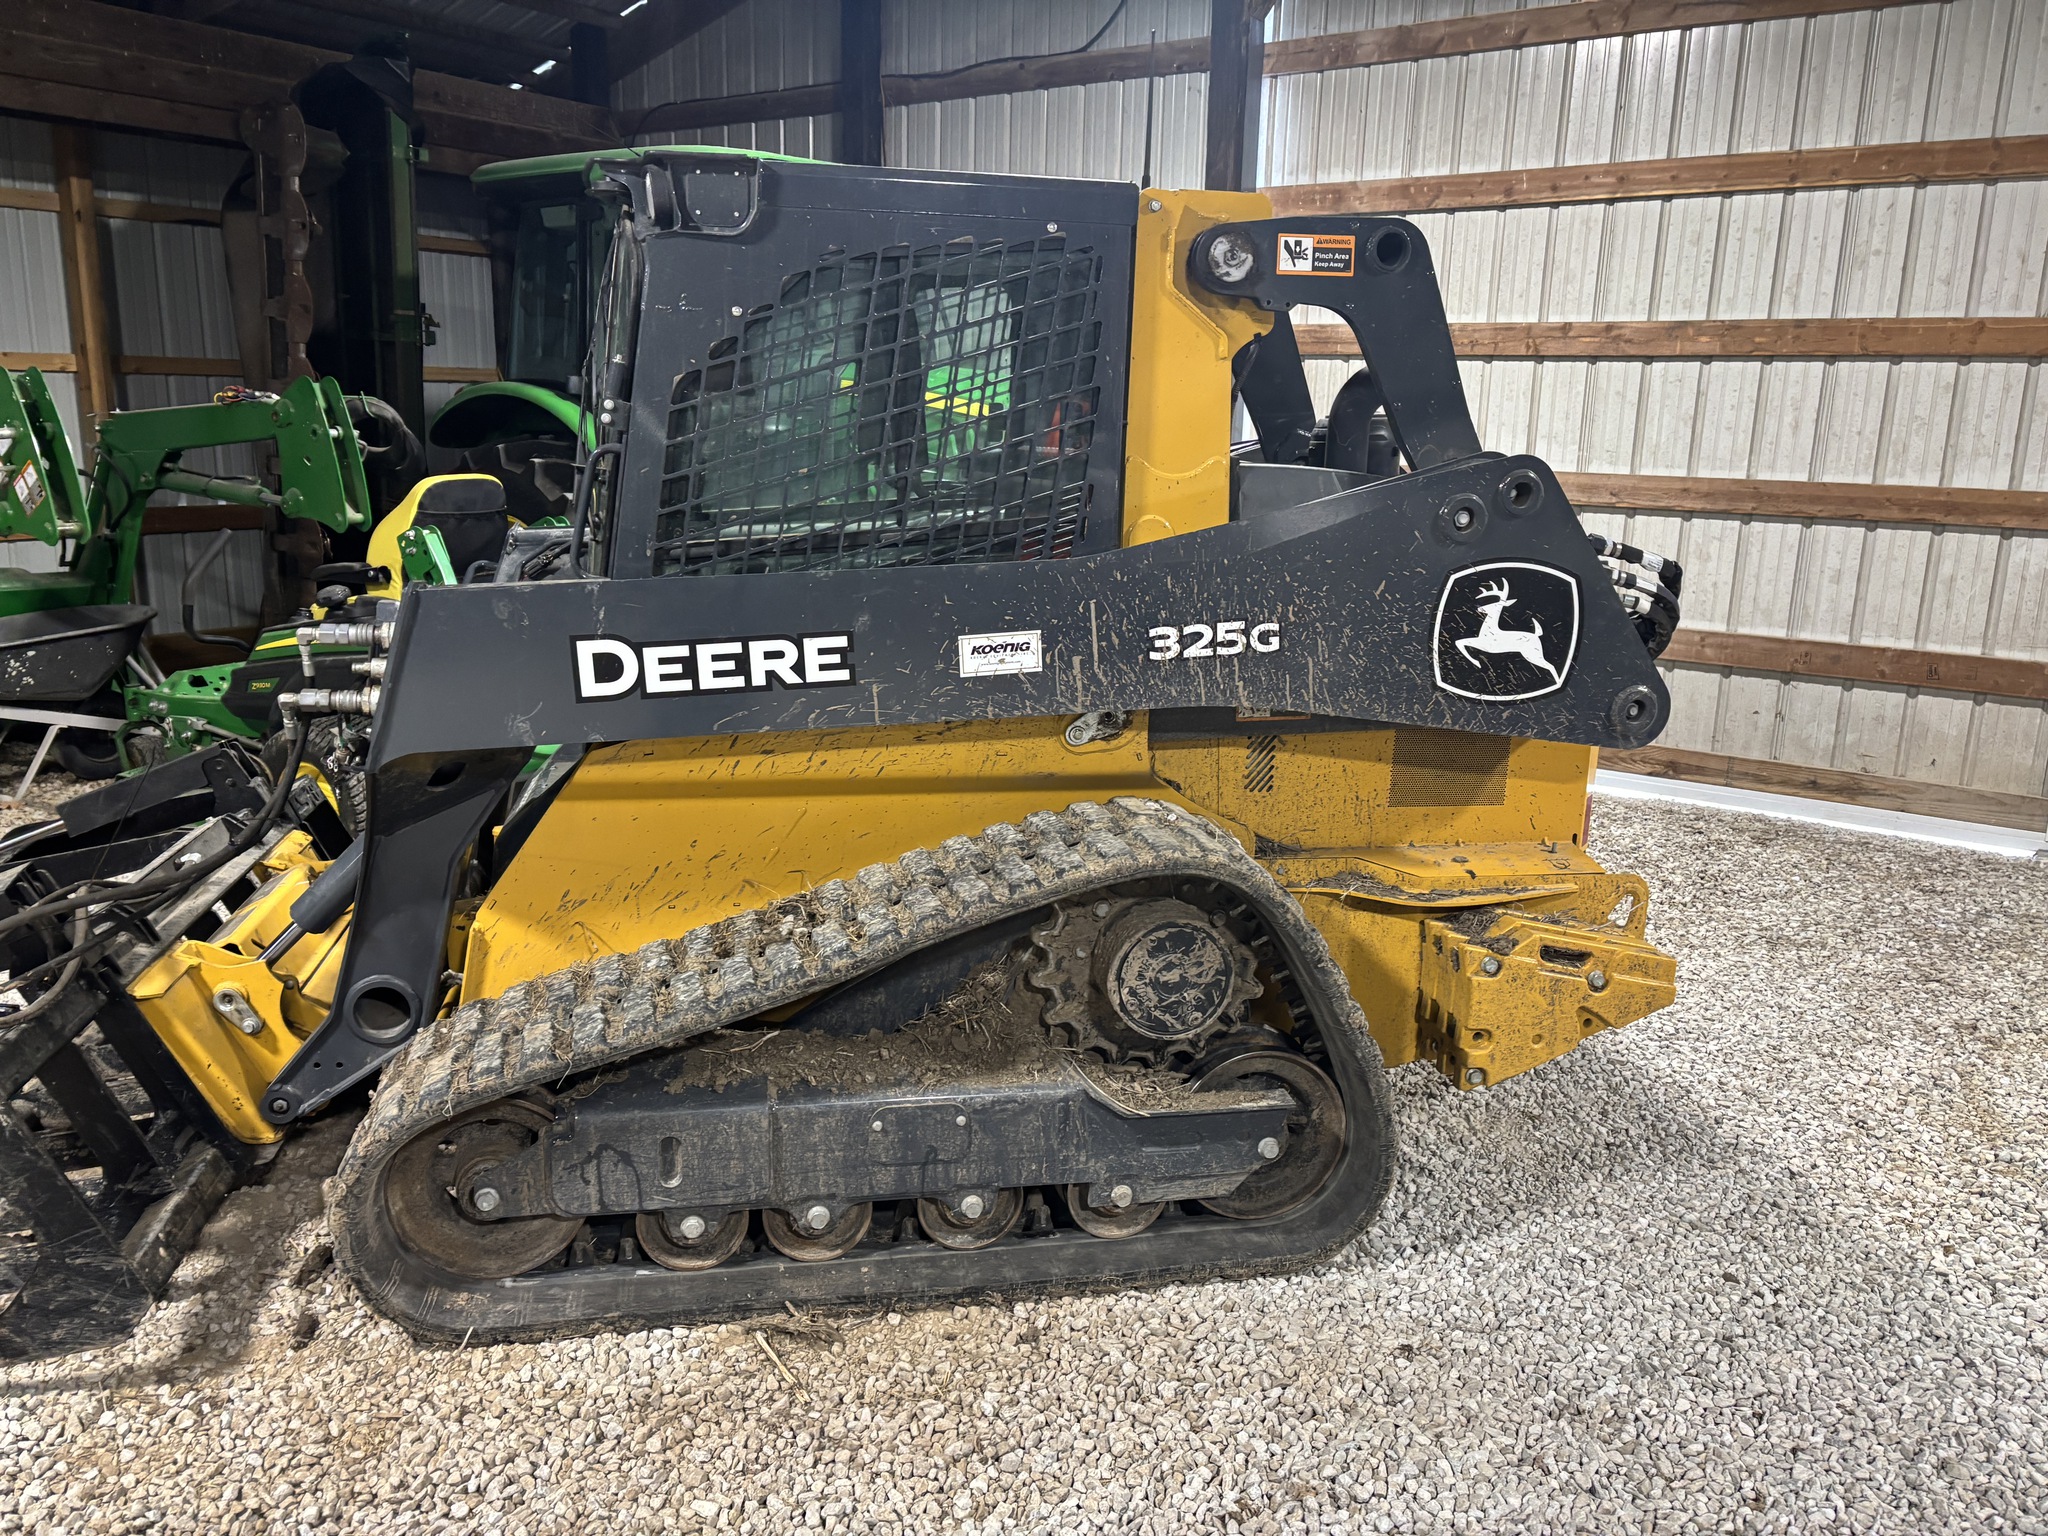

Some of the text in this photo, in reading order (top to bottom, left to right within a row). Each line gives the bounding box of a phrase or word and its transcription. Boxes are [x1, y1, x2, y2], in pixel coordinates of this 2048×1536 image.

[1334, 252, 1350, 260] Area
[1149, 620, 1280, 661] 325G
[575, 635, 851, 698] DEERE
